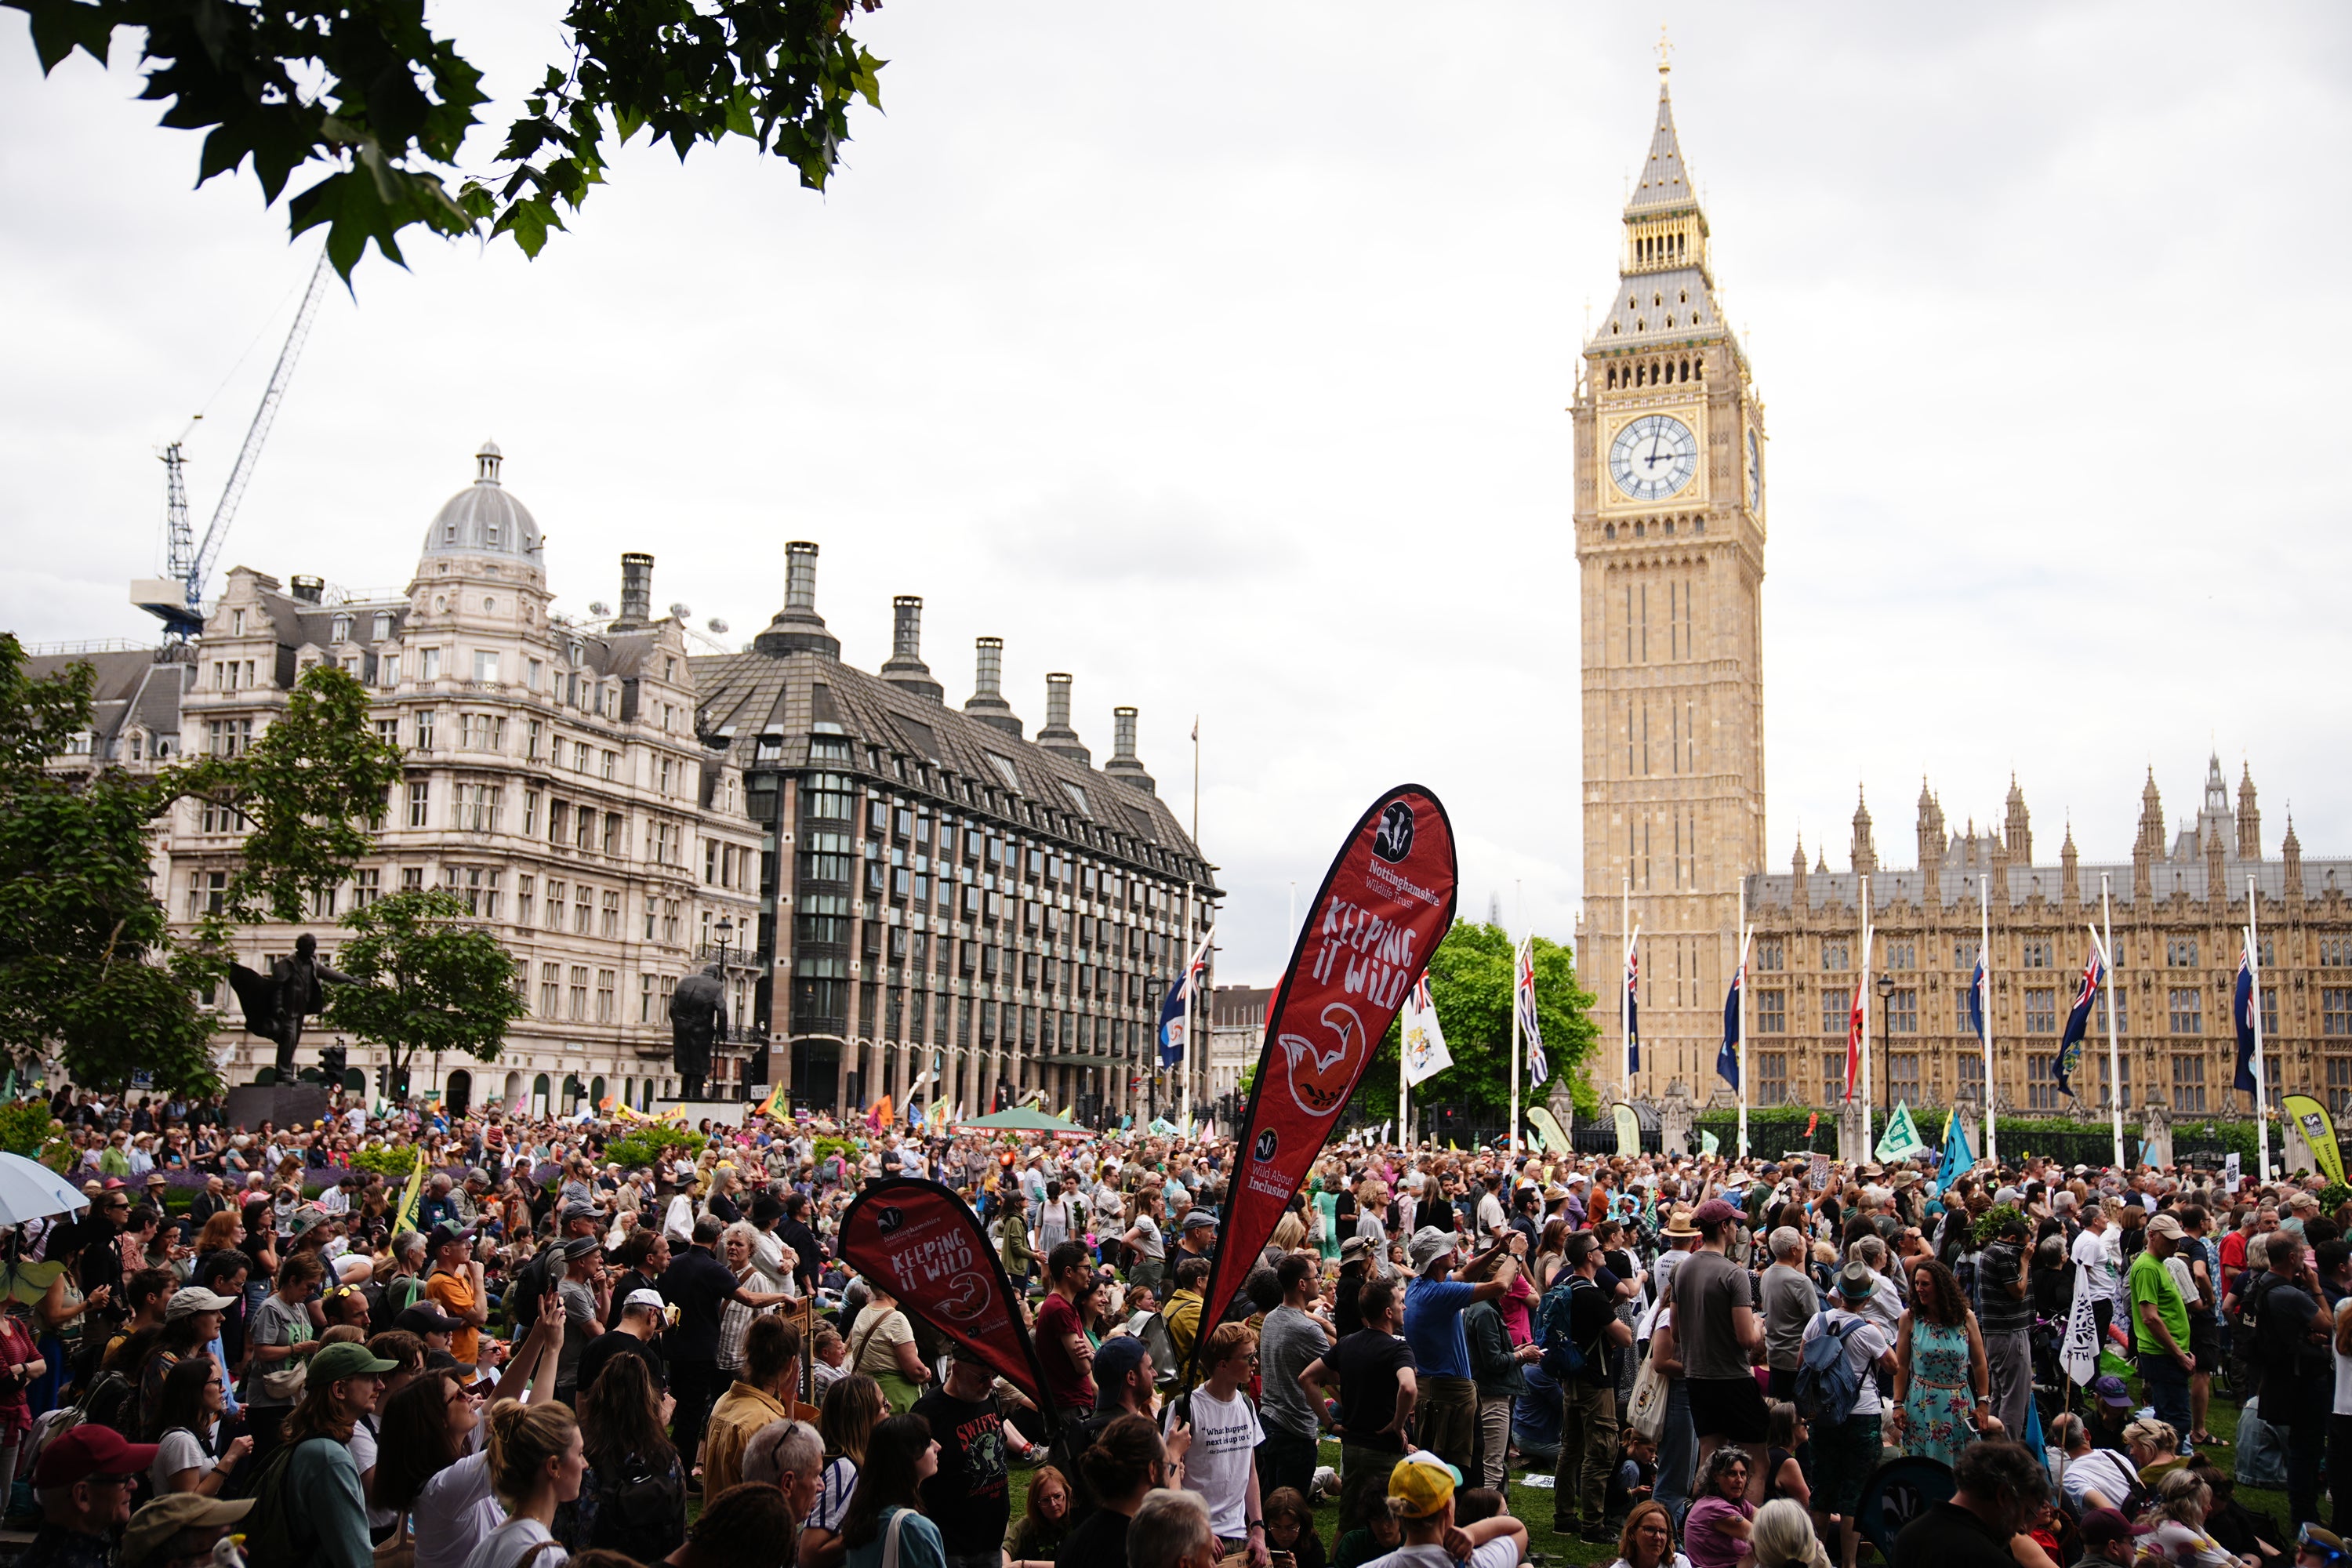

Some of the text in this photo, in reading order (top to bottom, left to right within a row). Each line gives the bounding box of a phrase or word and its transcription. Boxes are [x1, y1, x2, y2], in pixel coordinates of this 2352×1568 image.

[1366, 876, 1414, 909] Wildlife Trust
[1369, 859, 1440, 906] Nottinghamshire
[1253, 1163, 1294, 1185] Wild About
[1248, 1176, 1290, 1200] Inclusion
[883, 1217, 941, 1243] Nottinghamshire
[981, 1319, 1009, 1334] Inclusion
[1206, 1438, 1222, 1446] next
